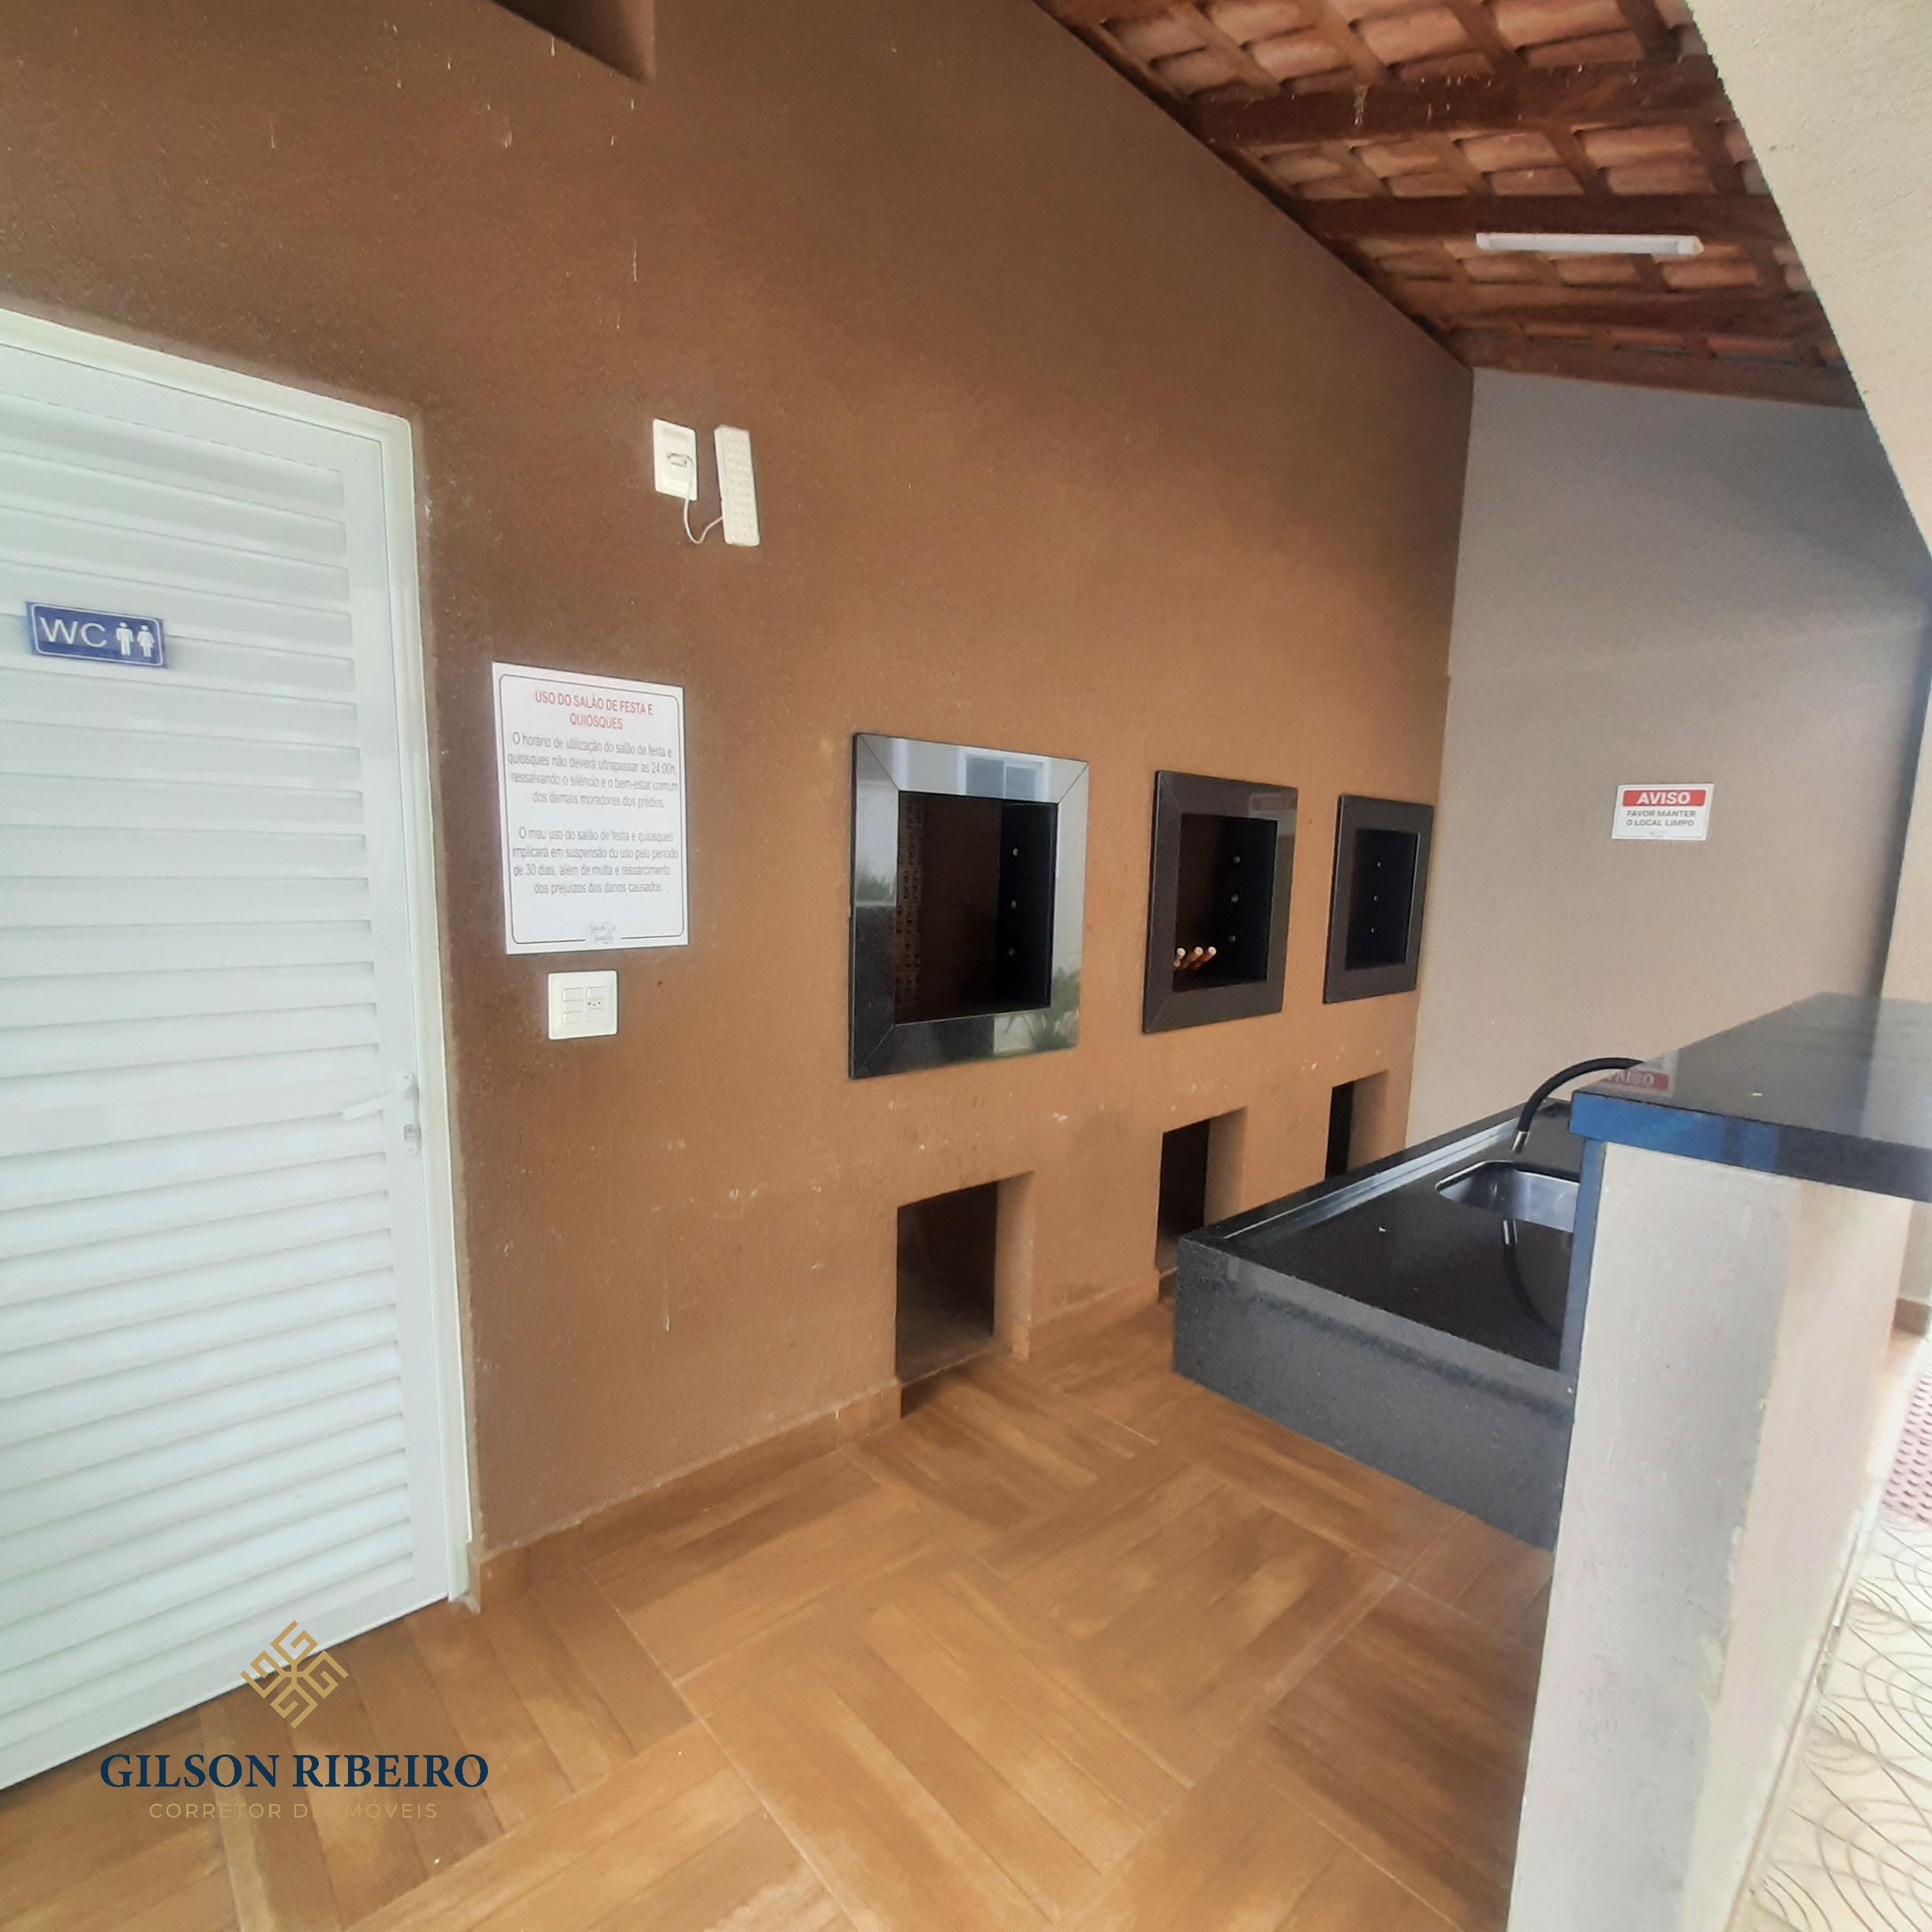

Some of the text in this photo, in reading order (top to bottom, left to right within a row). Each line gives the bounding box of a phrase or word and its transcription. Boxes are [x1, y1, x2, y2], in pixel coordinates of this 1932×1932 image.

[39, 616, 107, 648] WC
[535, 690, 653, 716] USO DO SALÃO DE FESTA E
[570, 713, 623, 730] QUIOSQUES
[512, 732, 672, 758] O horário de utilização do salão de festa e
[507, 754, 549, 769] quiosques
[552, 754, 567, 768] não
[569, 755, 597, 770] deverá
[598, 757, 639, 775] ultrapassar
[511, 771, 679, 793] ressalvando o silêncio e o bem-estar comum
[533, 791, 548, 803] dos
[549, 792, 578, 806] demais
[580, 794, 621, 807] moradores
[622, 795, 636, 807] dos
[1636, 791, 1690, 806] AVISO
[519, 826, 674, 844] O mau uso do salão de festa e quiosques
[550, 848, 564, 858] em
[565, 847, 607, 861] suspensão
[608, 847, 619, 859] do
[620, 849, 634, 859] uso
[635, 848, 650, 860] pelo
[513, 864, 524, 877] de
[526, 863, 537, 876] 30
[560, 863, 580, 876] além
[581, 863, 591, 876] de
[592, 863, 614, 876] multa
[615, 866, 620, 875] e
[621, 863, 672, 876] ressarcimento
[534, 882, 549, 894] dos
[588, 881, 602, 893] dos
[604, 881, 627, 893] danos
